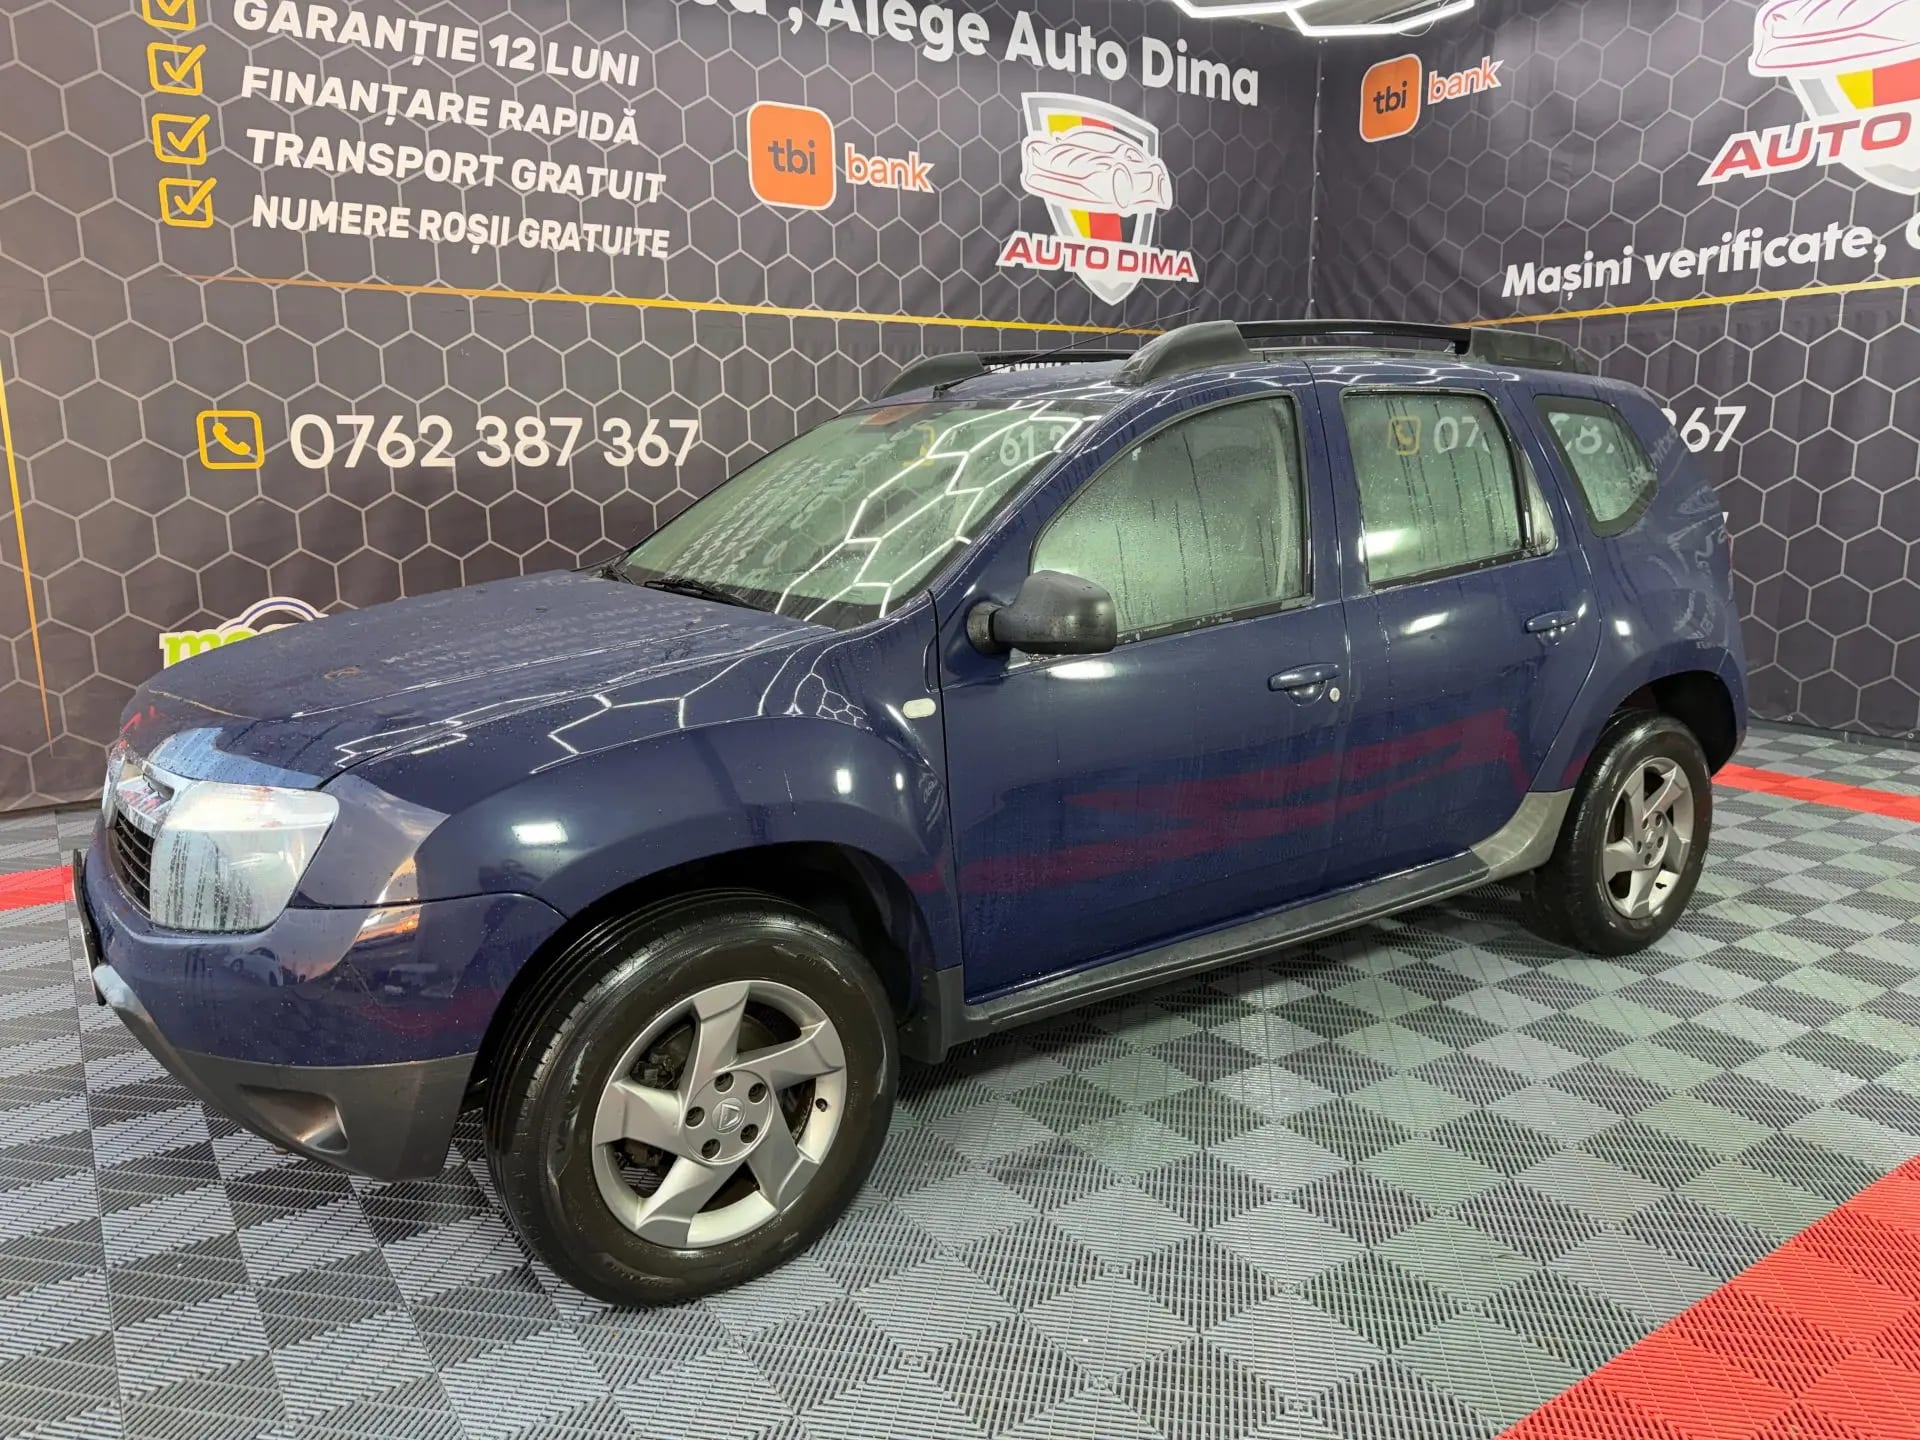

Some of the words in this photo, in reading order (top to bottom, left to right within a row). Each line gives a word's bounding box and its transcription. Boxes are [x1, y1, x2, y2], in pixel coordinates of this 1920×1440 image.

[233, 0, 478, 69] GARANȚIE
[488, 34, 536, 71] 12
[546, 42, 640, 86] LUNI
[816, 0, 990, 61] Alege
[1004, 11, 1128, 80] Auto
[1142, 38, 1259, 106] Dima
[240, 65, 489, 127] FINANȚARE
[499, 100, 640, 146] RAPIDĂ
[1373, 81, 1408, 115] tbi
[1429, 58, 1501, 103] bank
[246, 128, 503, 191] TRANSPORT
[510, 158, 666, 203] GRATUIT
[767, 138, 816, 176] tbi
[846, 145, 934, 192] bank
[1711, 112, 1911, 177] AUTO
[252, 194, 410, 240] NUMERE
[419, 215, 509, 255] ROȘII
[517, 217, 670, 259] GRATUITE
[1002, 235, 1110, 272] AUTO
[1117, 247, 1195, 279] DIMA
[1502, 247, 1632, 300] Mașini
[1645, 221, 1887, 281] verificate,
[290, 414, 456, 469] 0762
[475, 416, 583, 467] 387
[602, 417, 700, 467] 367
